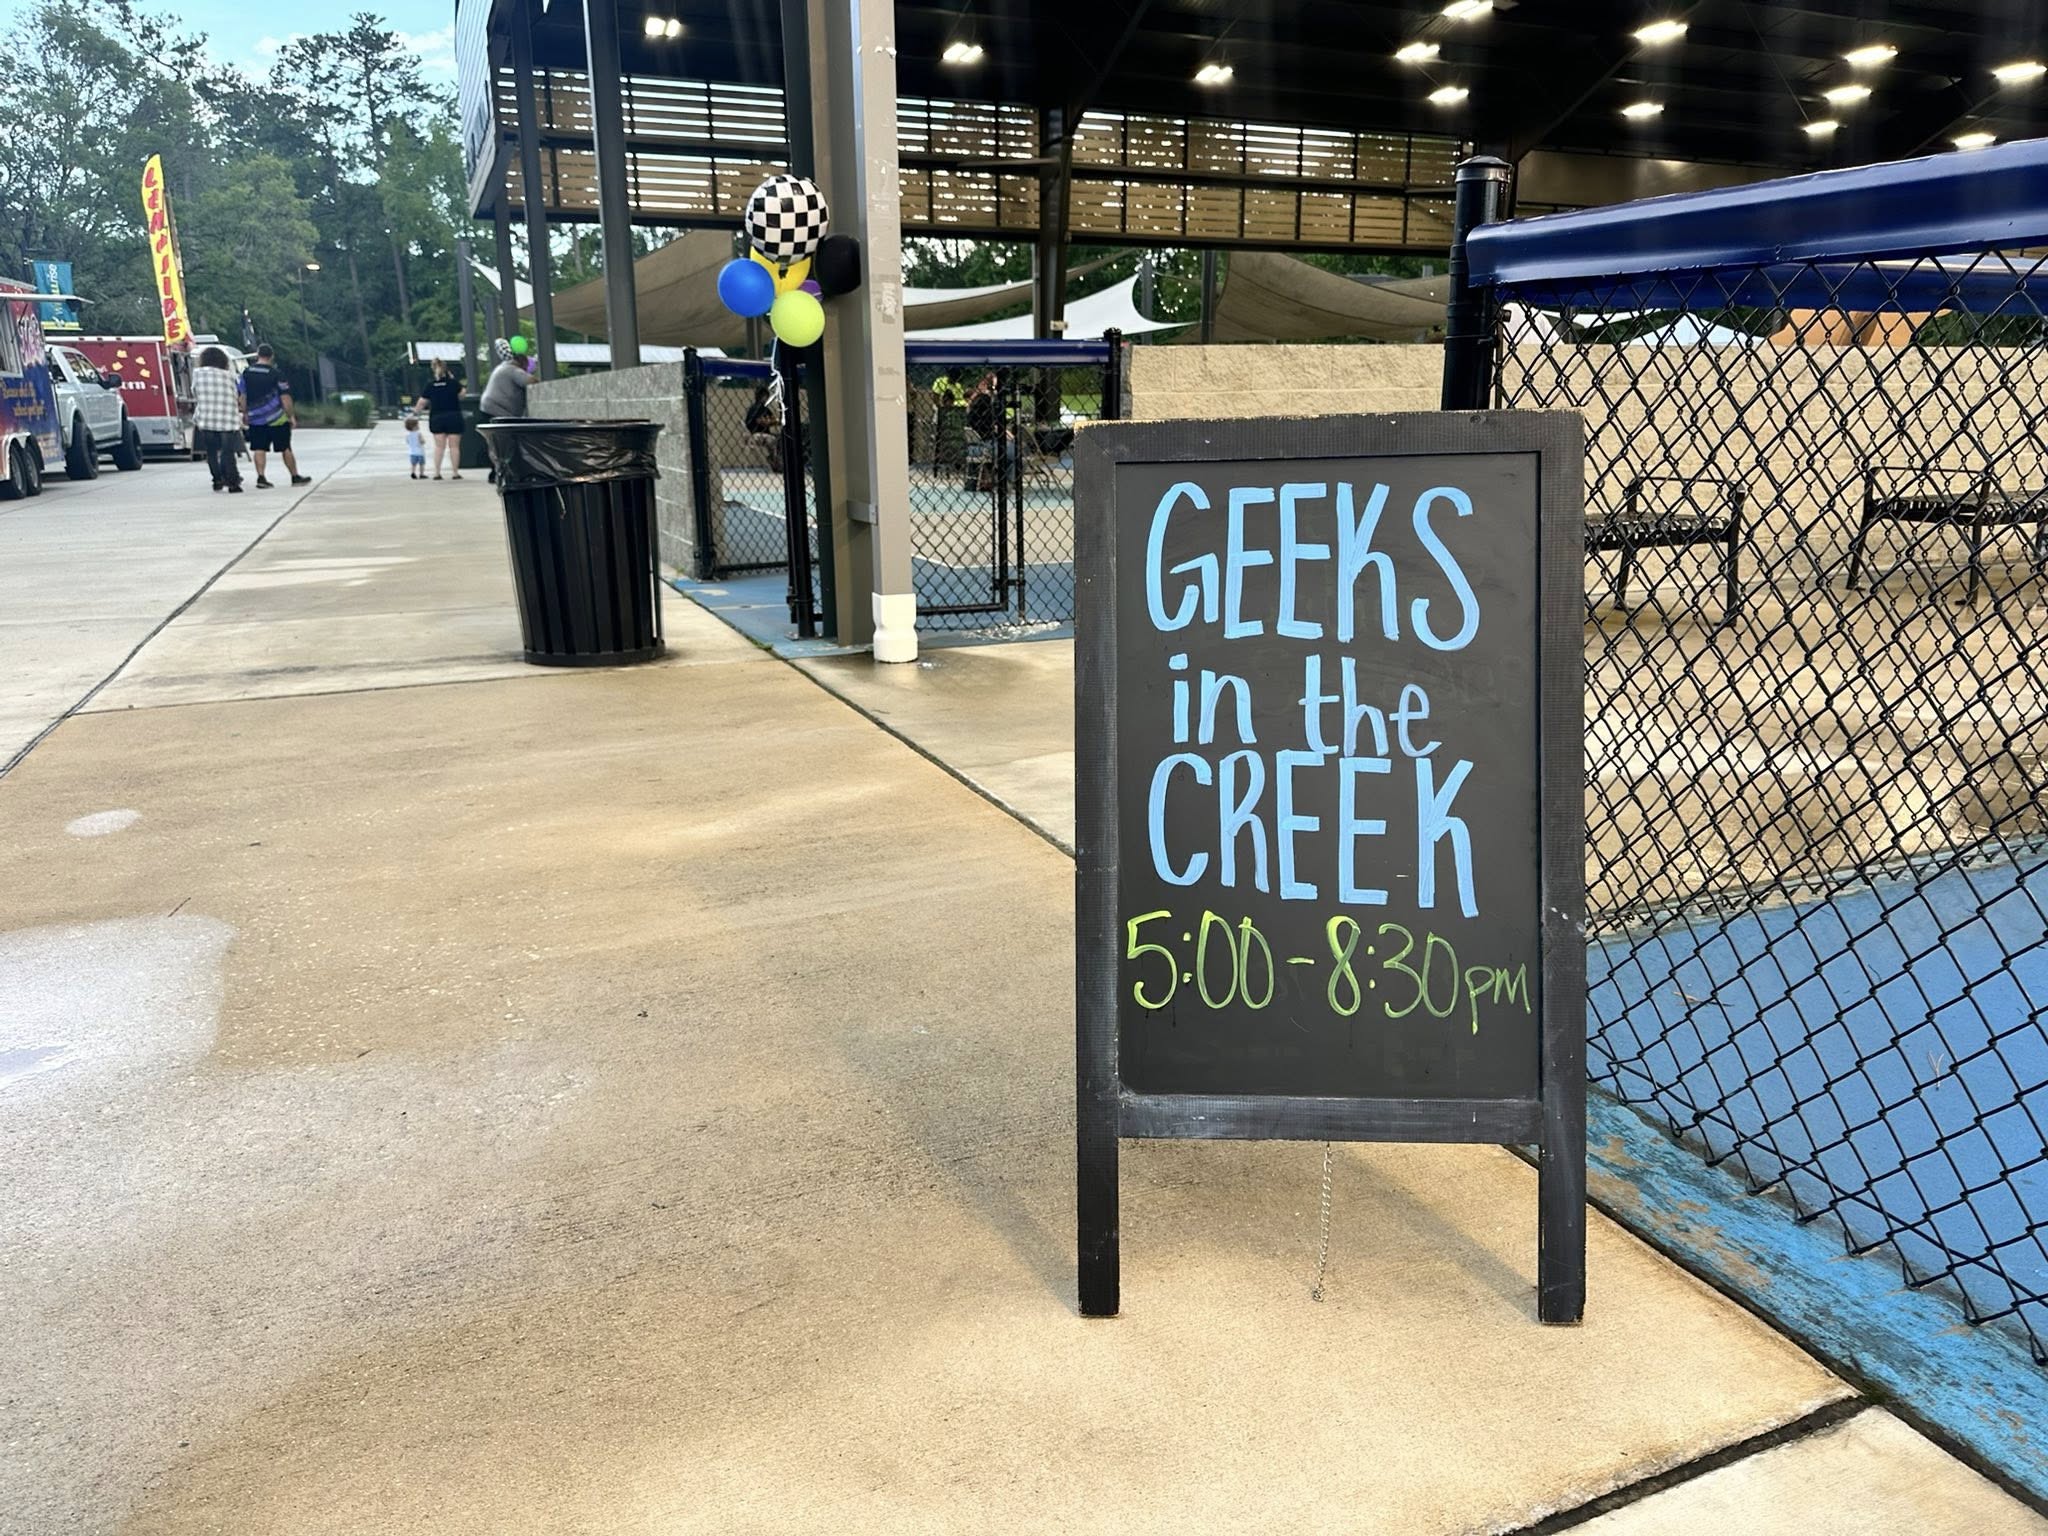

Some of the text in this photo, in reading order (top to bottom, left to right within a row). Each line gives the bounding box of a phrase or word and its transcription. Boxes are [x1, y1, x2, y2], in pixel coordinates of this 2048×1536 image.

[1145, 481, 1480, 651] GEEKS
[1168, 652, 1442, 758] in the
[1147, 748, 1480, 918] CREEK
